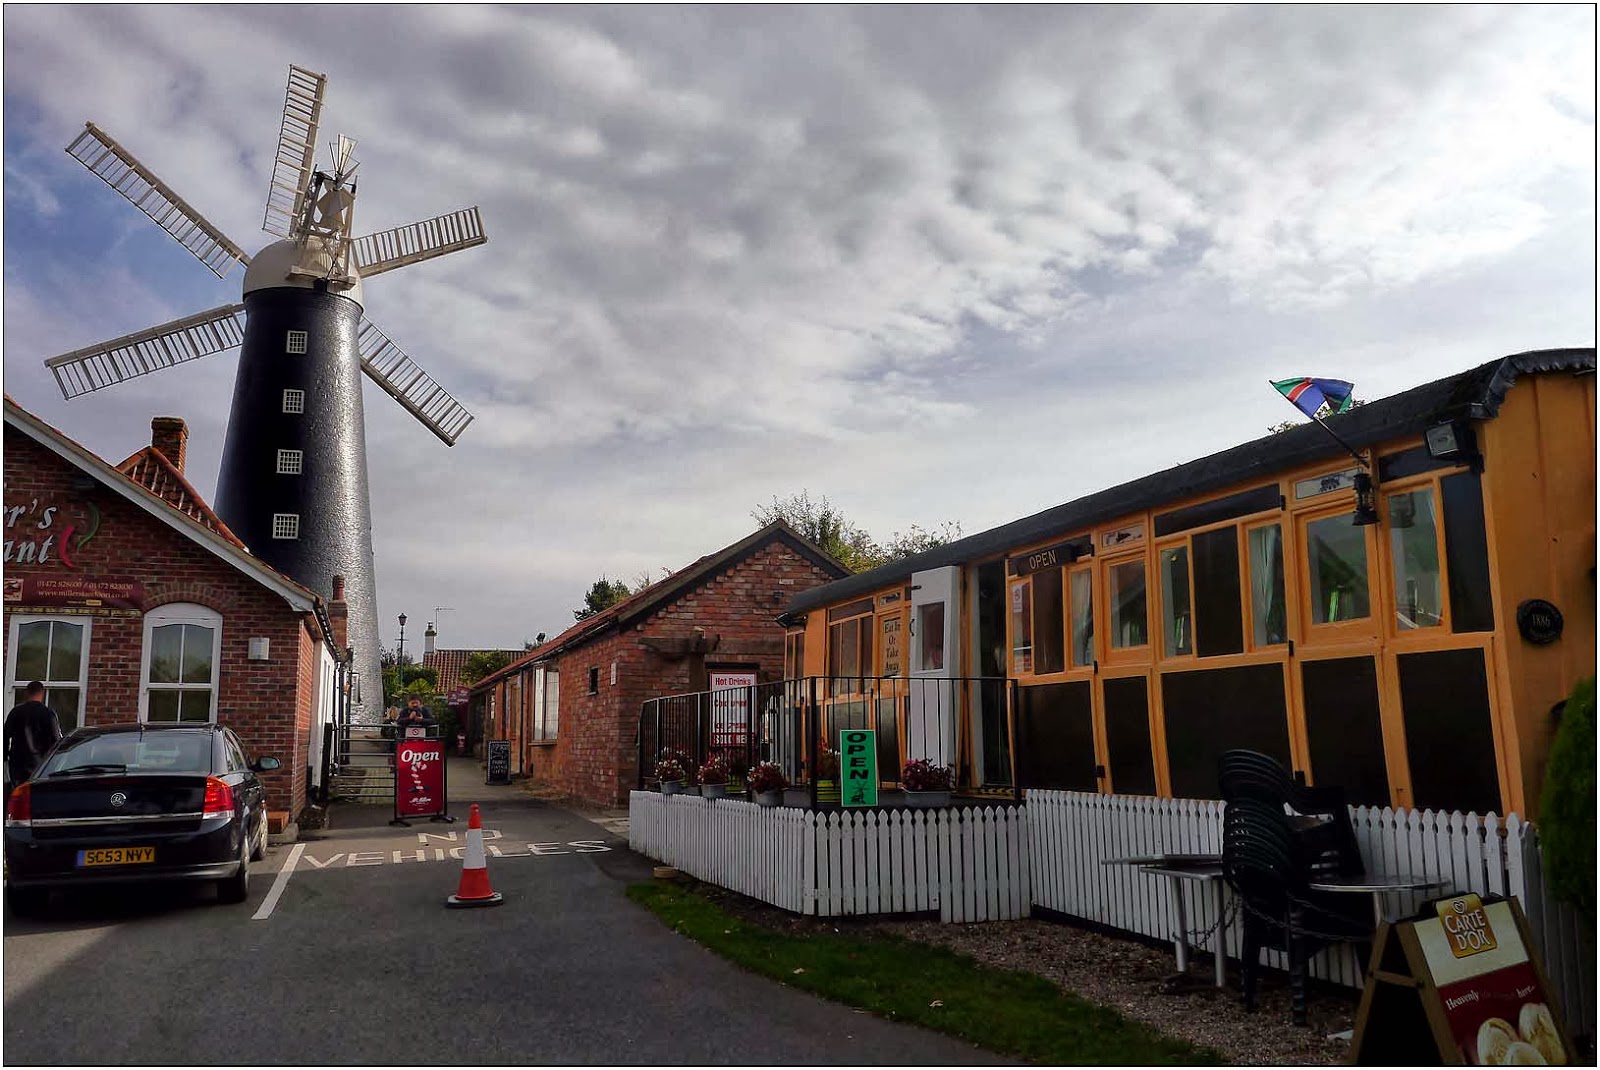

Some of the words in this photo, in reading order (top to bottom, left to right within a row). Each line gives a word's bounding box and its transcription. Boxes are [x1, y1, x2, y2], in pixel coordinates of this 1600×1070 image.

[4, 498, 57, 529] r's
[1029, 549, 1057, 570] OPEN
[886, 647, 899, 658] Take
[715, 677, 728, 686] Hot
[728, 677, 752, 686] Drinks
[401, 749, 440, 766] Open
[847, 732, 869, 780] OPEN
[418, 829, 504, 843] NO
[86, 849, 122, 863] SC53
[126, 848, 154, 862] NVY
[1445, 909, 1486, 934] CARTE
[1455, 929, 1491, 951] D'OR
[1445, 989, 1479, 1011] Heavenly
